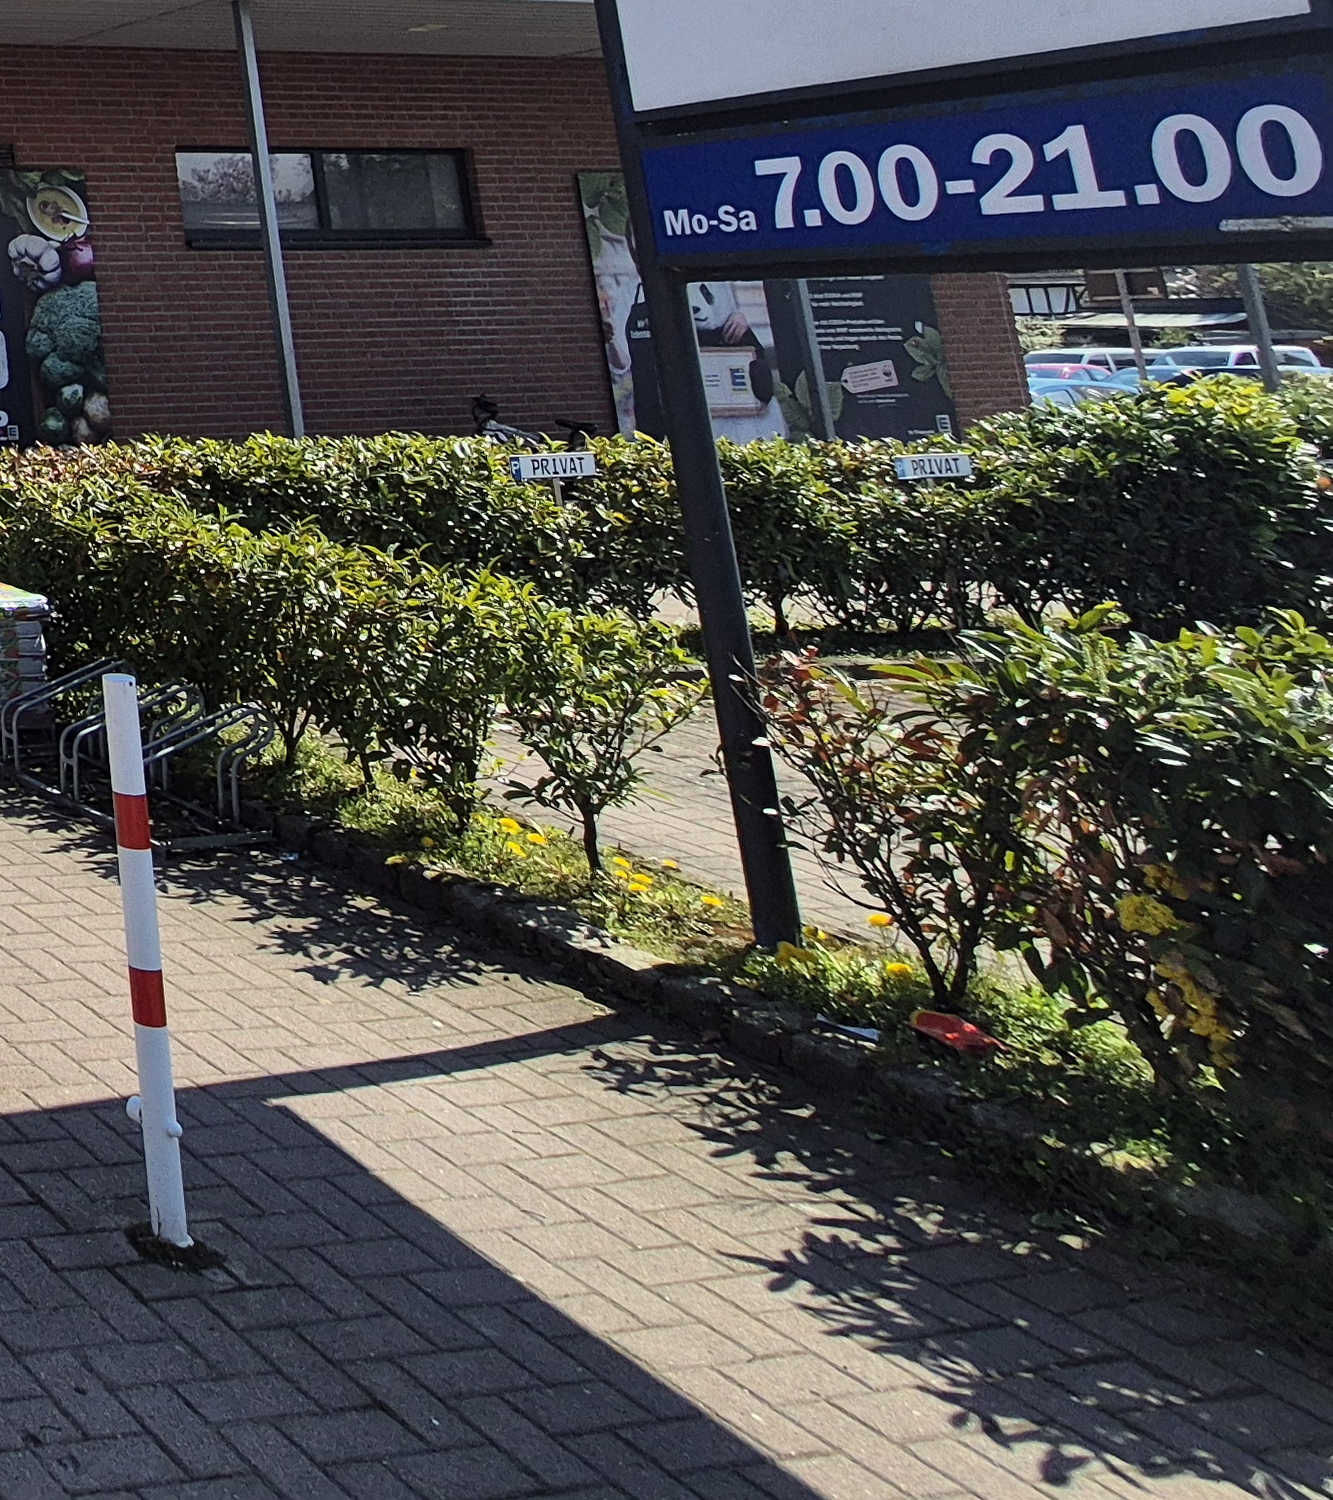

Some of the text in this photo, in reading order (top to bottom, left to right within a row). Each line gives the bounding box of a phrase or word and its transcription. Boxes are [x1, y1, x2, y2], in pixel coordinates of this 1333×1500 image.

[663, 103, 1325, 236] Mo-Sa 7.00-21.00
[531, 457, 585, 476] PRIVAT
[911, 458, 960, 476] PRIVAT
